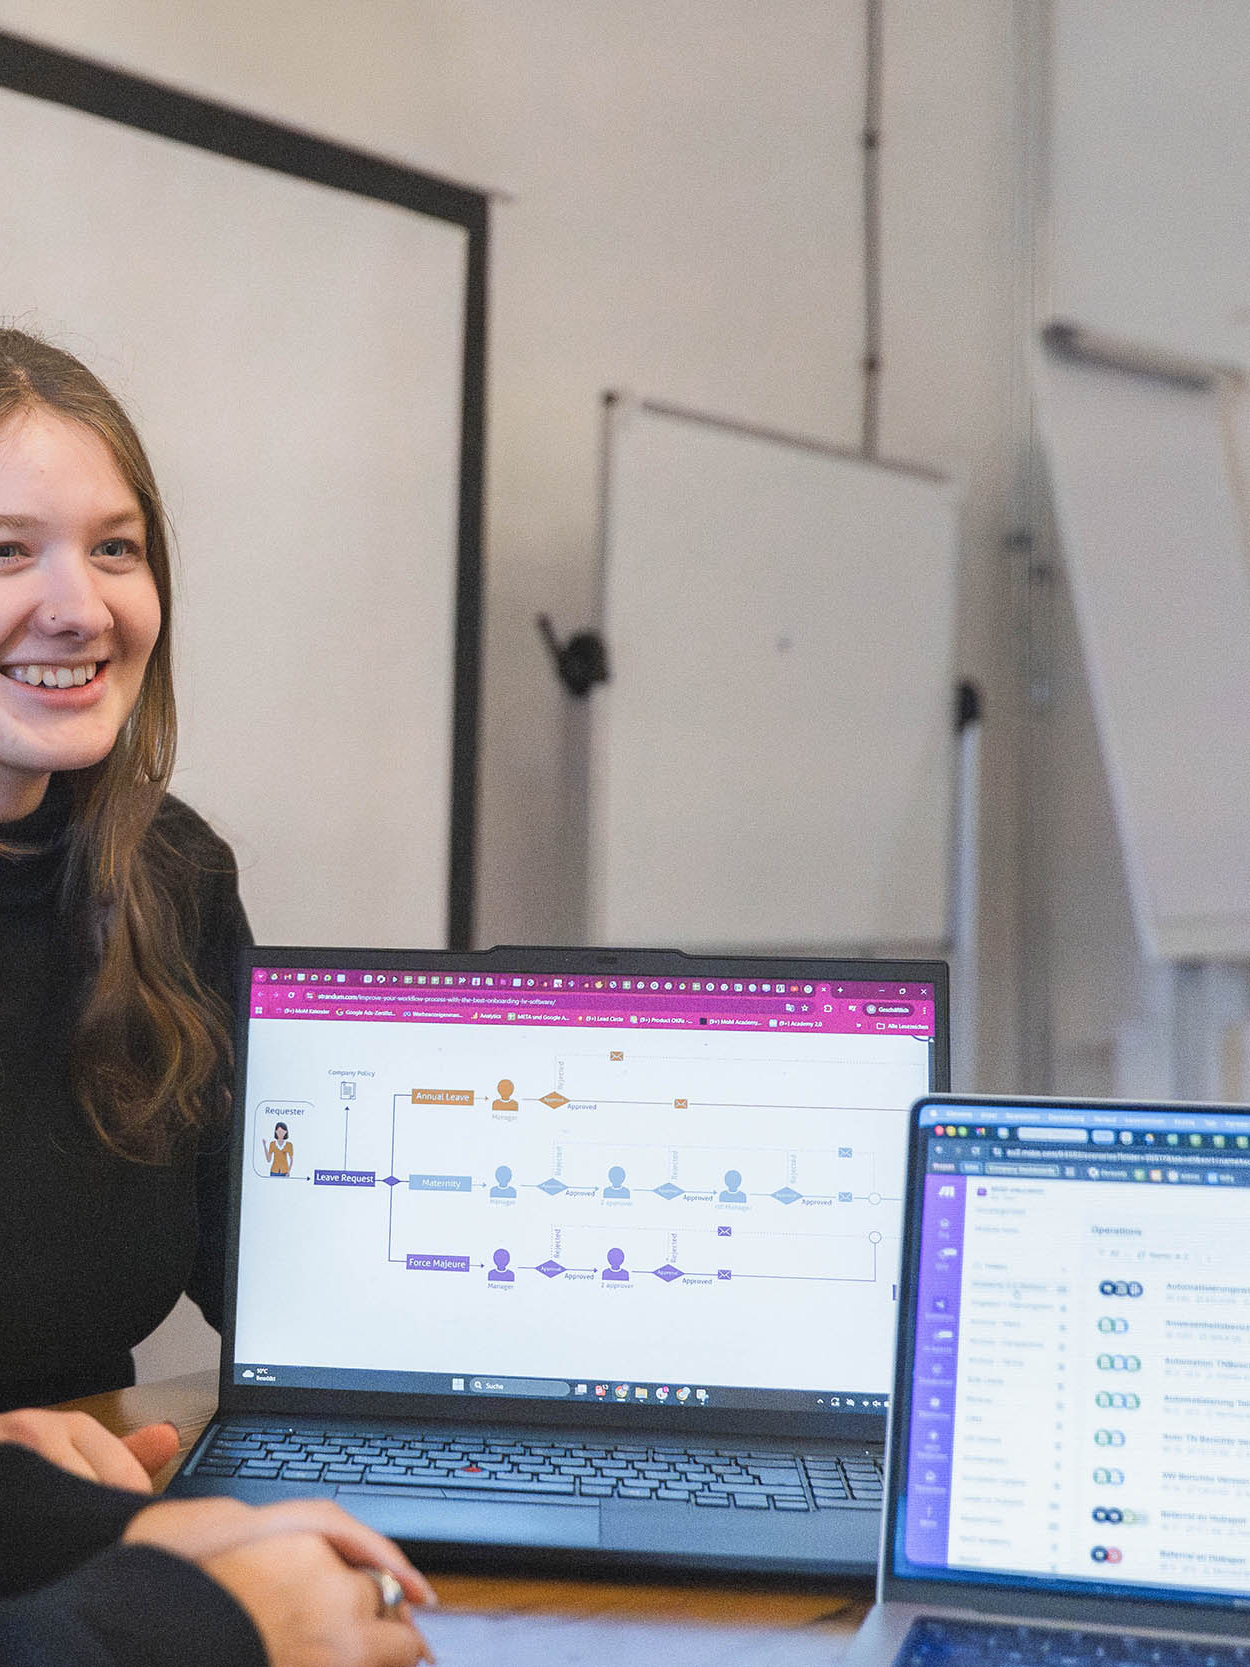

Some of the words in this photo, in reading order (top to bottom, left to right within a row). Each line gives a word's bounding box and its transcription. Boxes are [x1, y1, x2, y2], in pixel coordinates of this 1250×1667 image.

[791, 1020, 814, 1028] Academy
[328, 1068, 356, 1078] Company
[357, 1069, 376, 1078] Policy
[557, 1060, 565, 1090] Rejected
[416, 1091, 445, 1101] Annual
[446, 1093, 470, 1102] Leave
[265, 1106, 305, 1117] Requester
[567, 1103, 598, 1111] Approved
[491, 1113, 518, 1122] Manager
[316, 1173, 340, 1182] Leave
[341, 1174, 375, 1185] Request
[421, 1177, 462, 1189] Maternity
[565, 1190, 596, 1198] Approved
[683, 1194, 713, 1202] Approved
[801, 1198, 833, 1206] Approved
[1091, 1225, 1142, 1238] Operations
[553, 1228, 561, 1259] Rejected
[670, 1232, 678, 1263] Rejected
[409, 1258, 431, 1268] Force
[432, 1259, 467, 1270] Majeure
[564, 1272, 595, 1281] Approved
[682, 1277, 713, 1286] Approved
[487, 1283, 514, 1291] Manager
[485, 1382, 504, 1390] Suche
